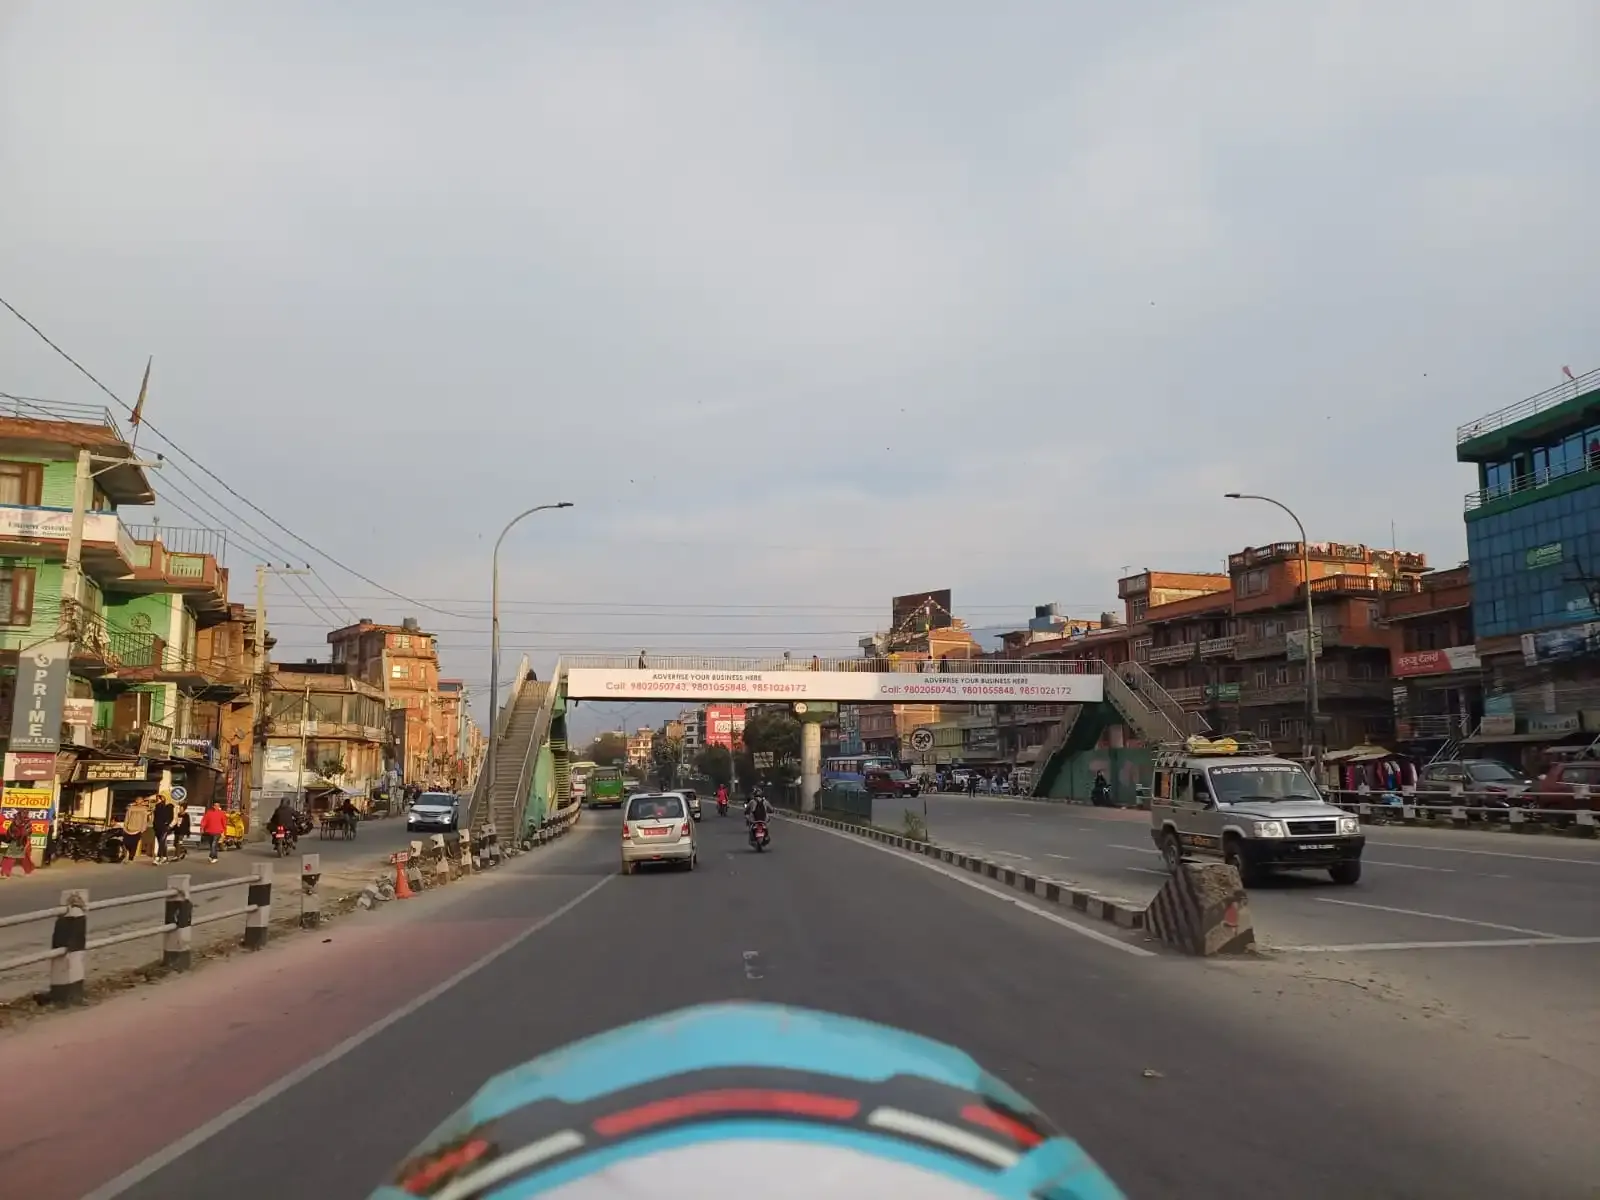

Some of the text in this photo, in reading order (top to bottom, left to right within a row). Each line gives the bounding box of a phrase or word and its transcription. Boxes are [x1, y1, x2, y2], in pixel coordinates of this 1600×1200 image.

[1019, 686, 1072, 695] 9851026172
[172, 738, 211, 746] PHARMACY
[4, 794, 50, 806] फोटोकपी
